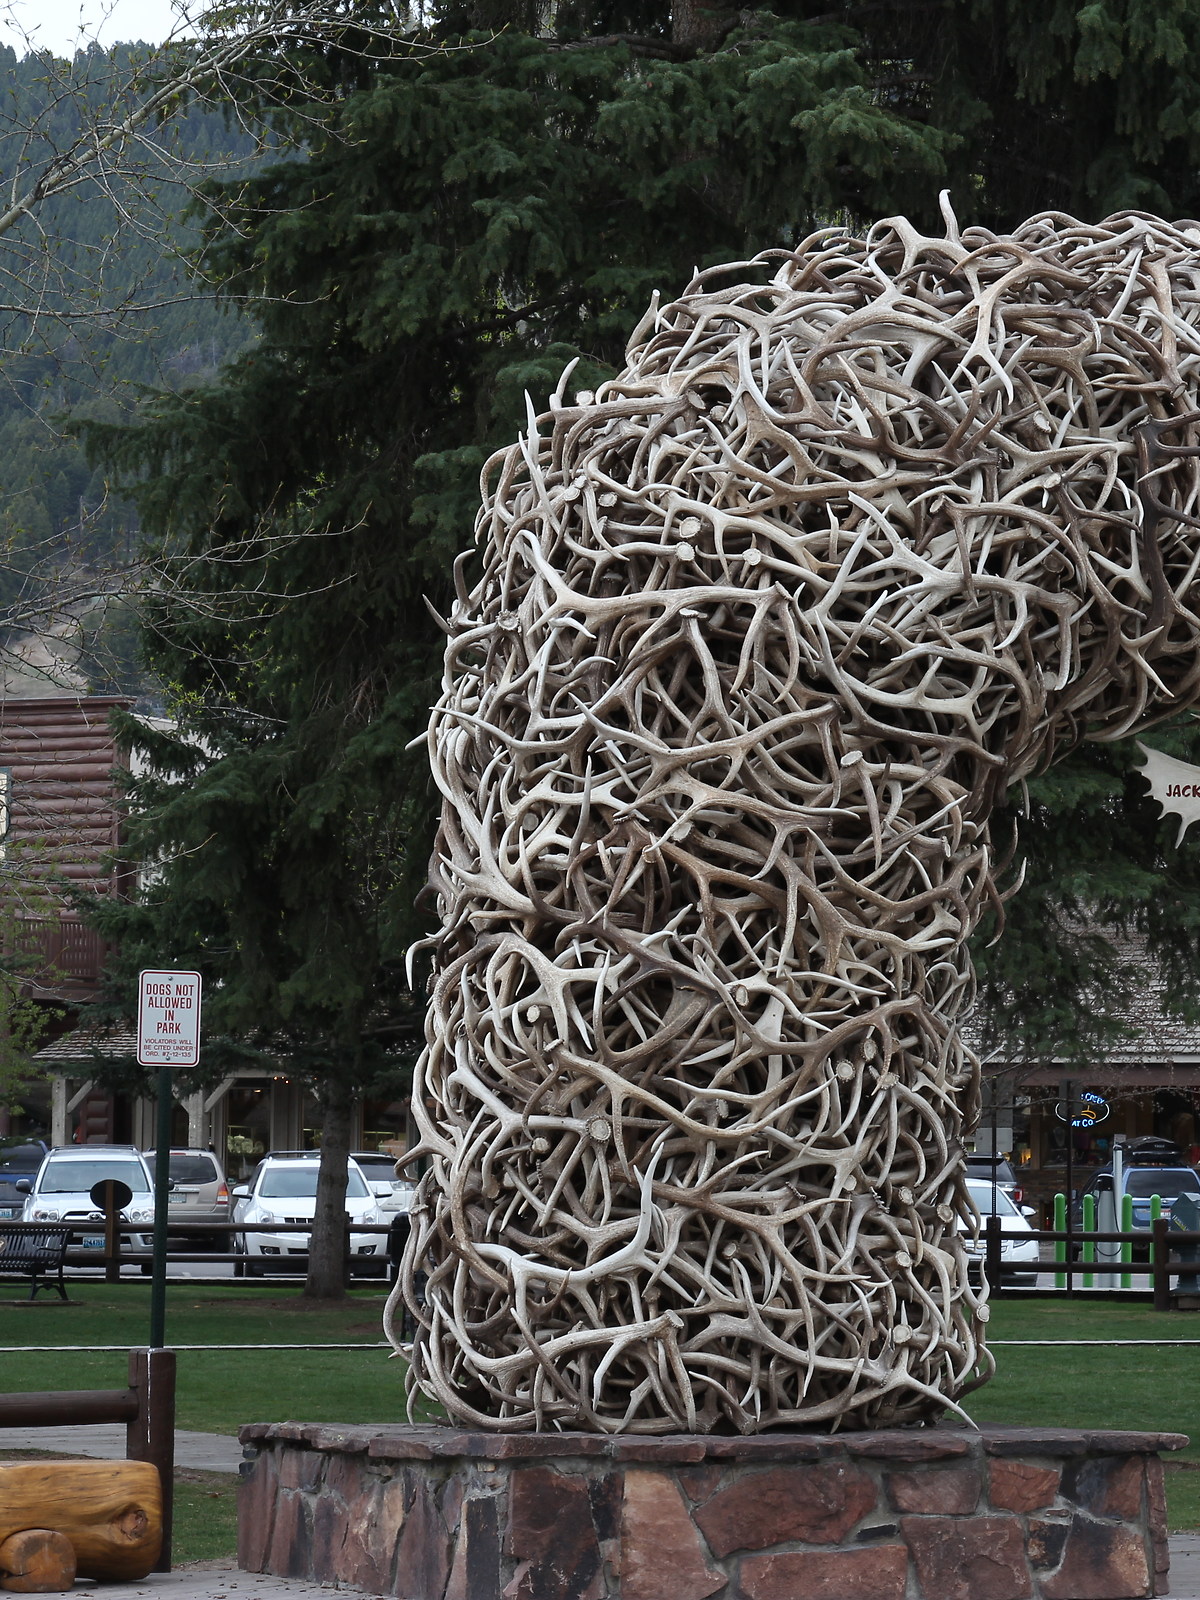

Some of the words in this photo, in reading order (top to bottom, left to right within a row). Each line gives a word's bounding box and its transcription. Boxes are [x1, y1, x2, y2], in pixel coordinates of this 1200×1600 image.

[146, 983, 172, 995] DOGS
[175, 984, 194, 996] NOT
[148, 996, 192, 1009] ALLOWED
[164, 1009, 175, 1021] IN
[156, 1022, 181, 1034] PARK
